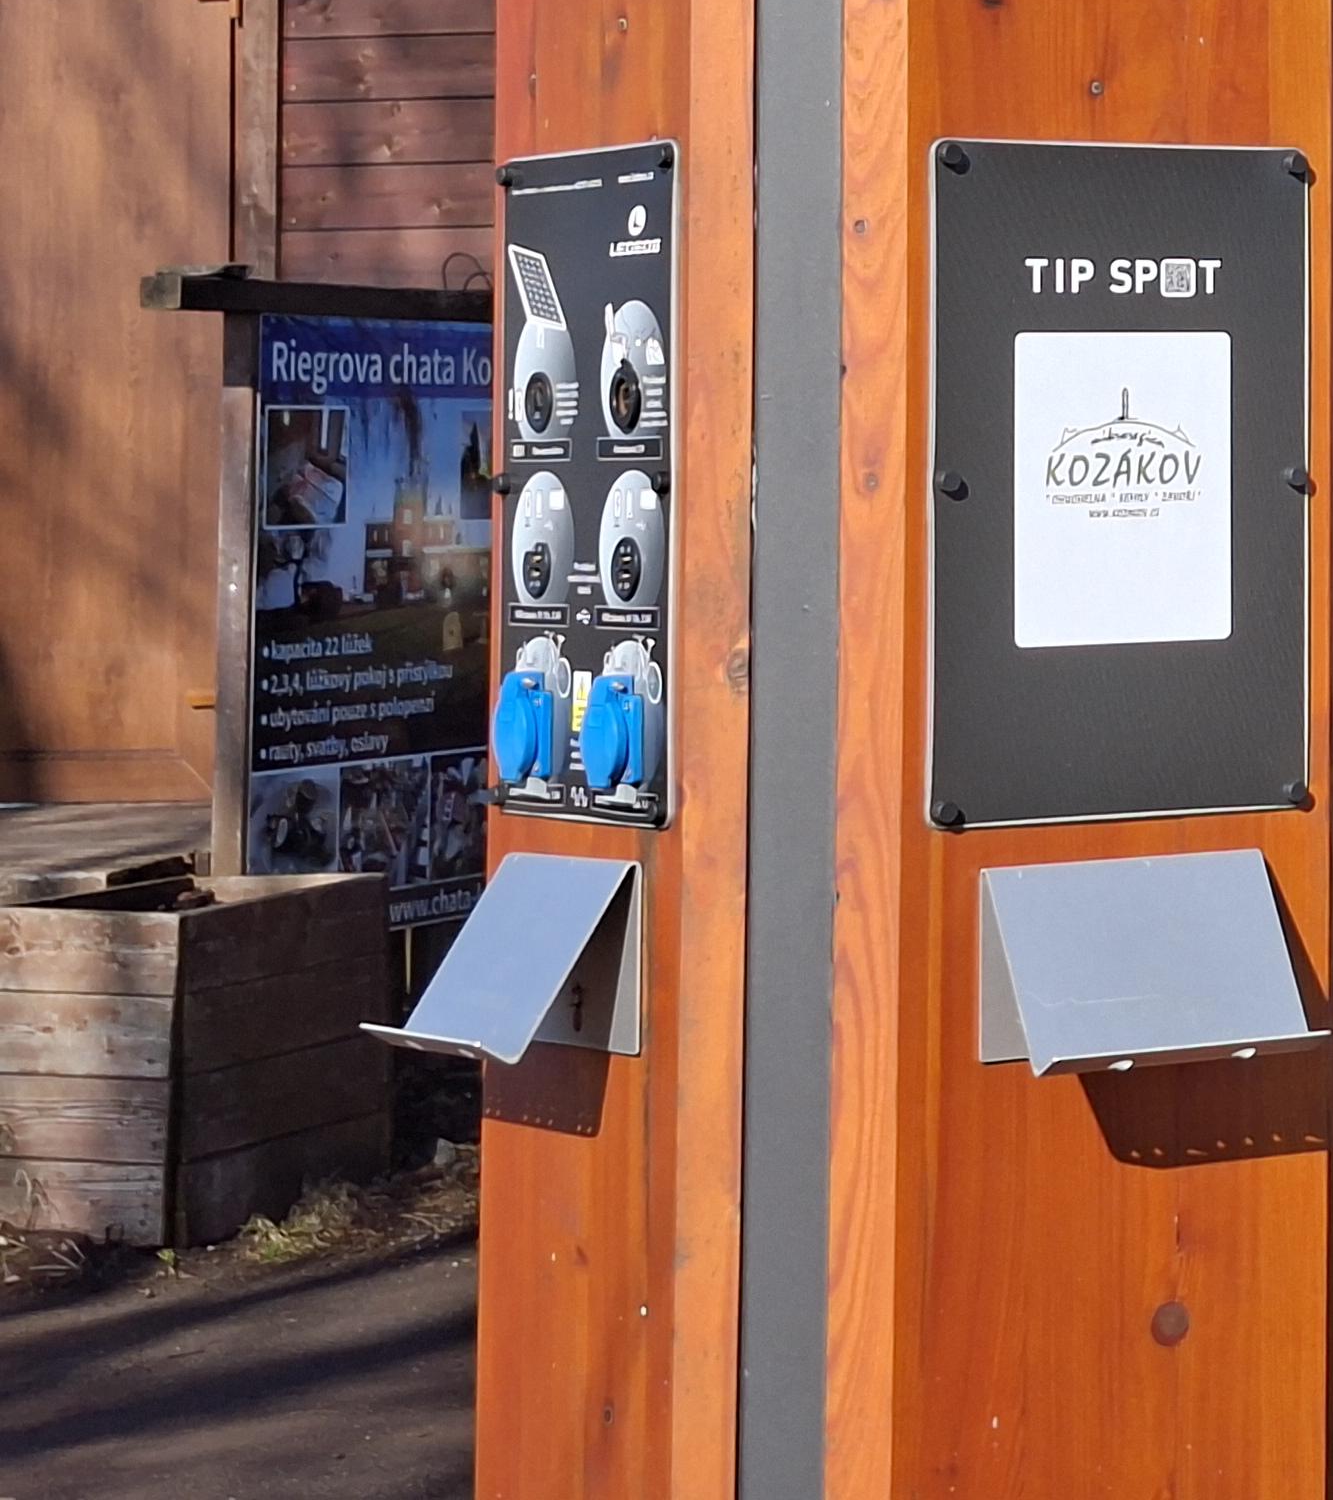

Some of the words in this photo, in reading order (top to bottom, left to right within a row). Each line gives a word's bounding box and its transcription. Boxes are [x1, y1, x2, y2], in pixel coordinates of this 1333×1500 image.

[1024, 257, 1095, 294] TIP
[1109, 258, 1222, 298] SPOT
[272, 338, 383, 395] Riegrova
[389, 342, 455, 385] chata
[1046, 447, 1201, 488] KOZÁKOV
[325, 636, 339, 656] 22
